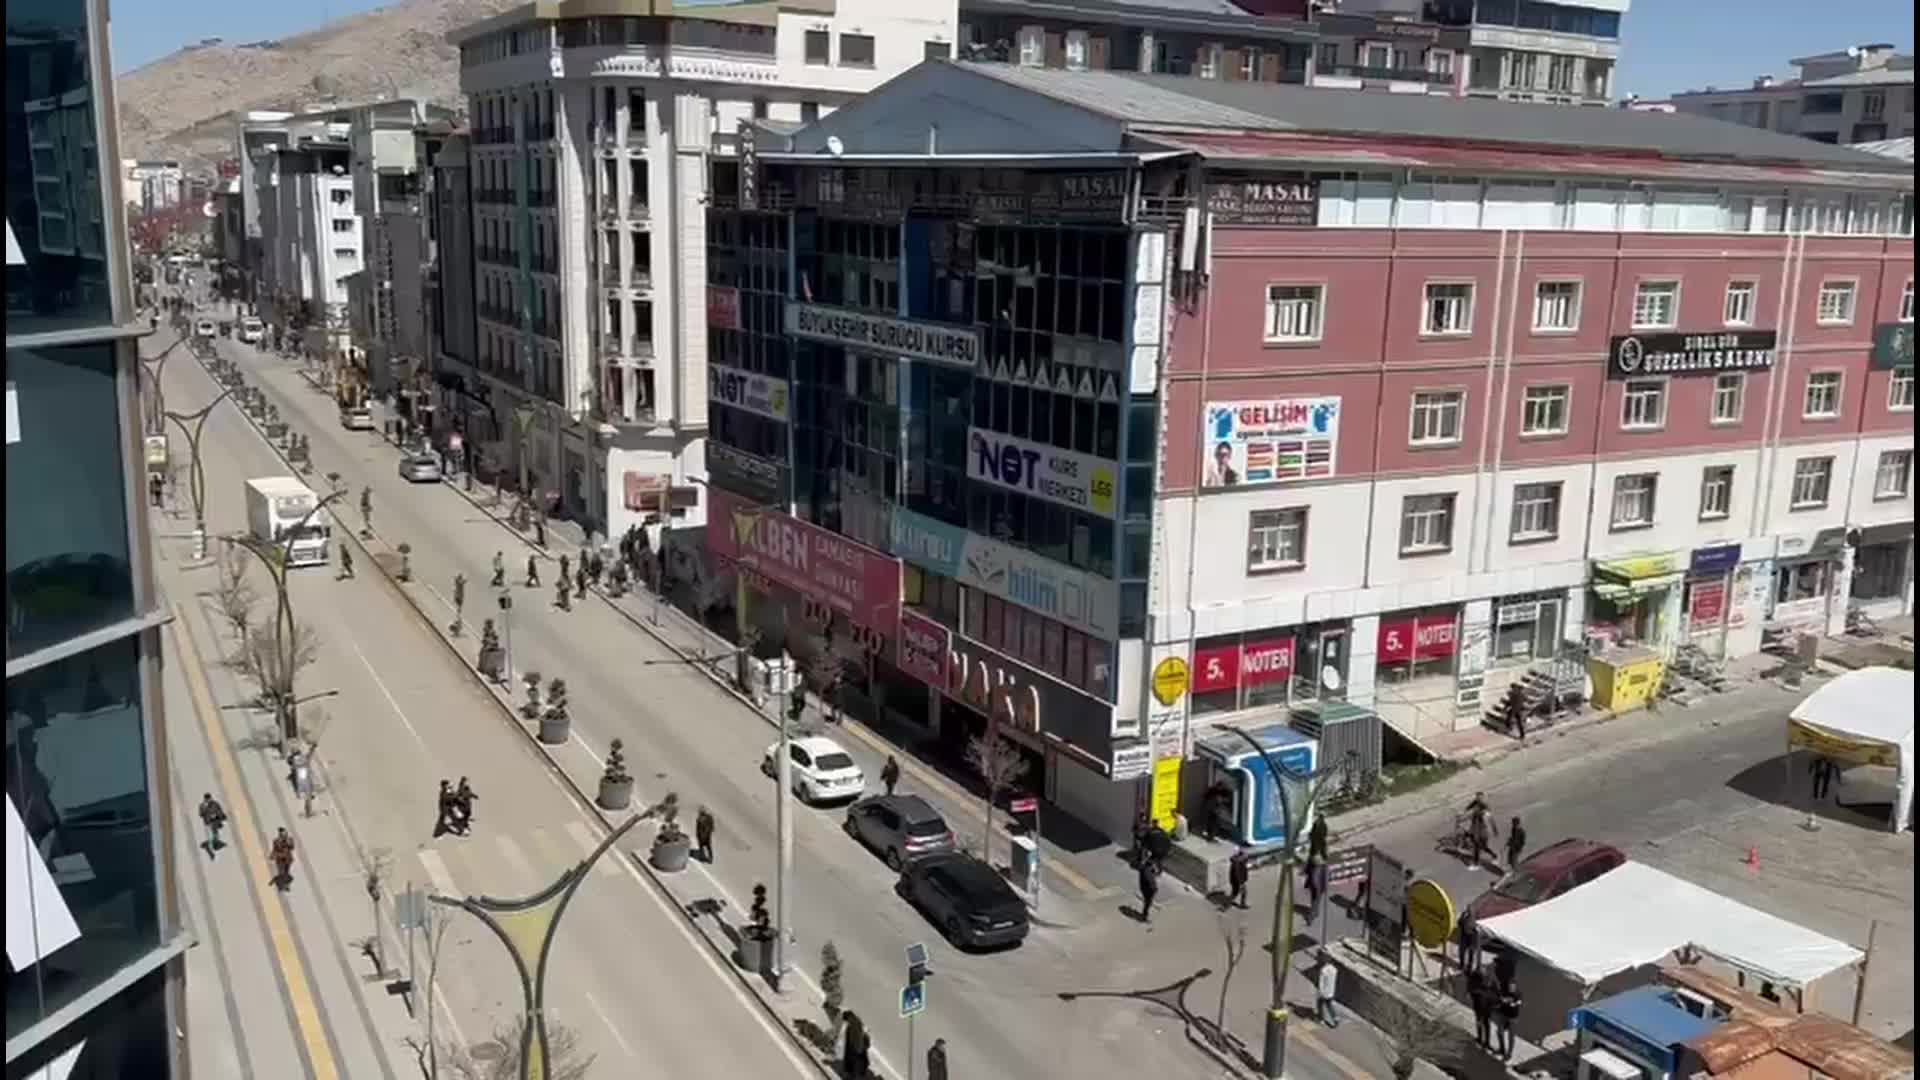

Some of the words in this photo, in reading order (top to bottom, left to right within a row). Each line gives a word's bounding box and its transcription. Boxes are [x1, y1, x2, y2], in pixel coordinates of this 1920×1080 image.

[1244, 183, 1313, 201] MASAL
[925, 327, 977, 361] KURSU
[977, 437, 1041, 490] NOT
[1386, 630, 1405, 651] 5.
[1207, 656, 1225, 680] 5.
[1243, 648, 1289, 673] NOTER
